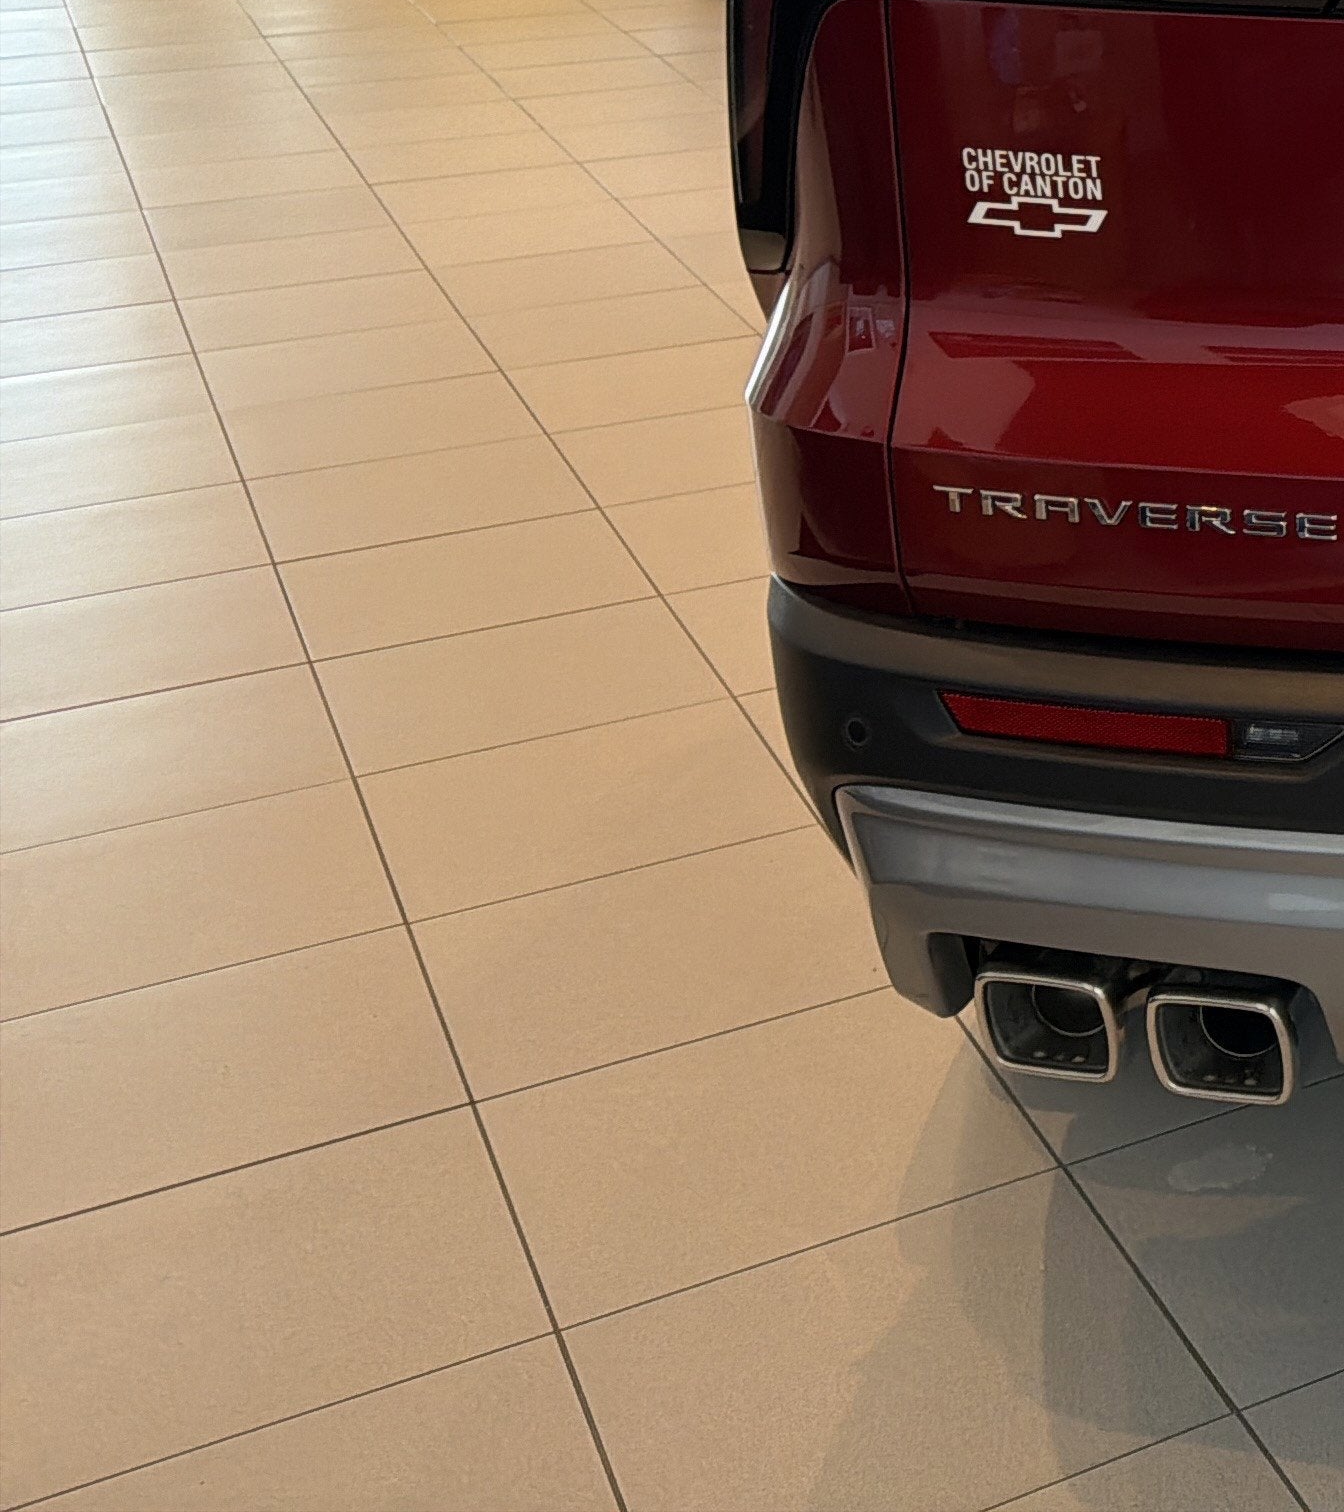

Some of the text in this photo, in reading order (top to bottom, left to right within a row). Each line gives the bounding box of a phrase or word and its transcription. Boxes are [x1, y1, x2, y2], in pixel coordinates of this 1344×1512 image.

[962, 147, 1101, 178] CHEVROLET
[965, 170, 1103, 201] OF CANTON
[933, 484, 1338, 541] TRAVERSE
